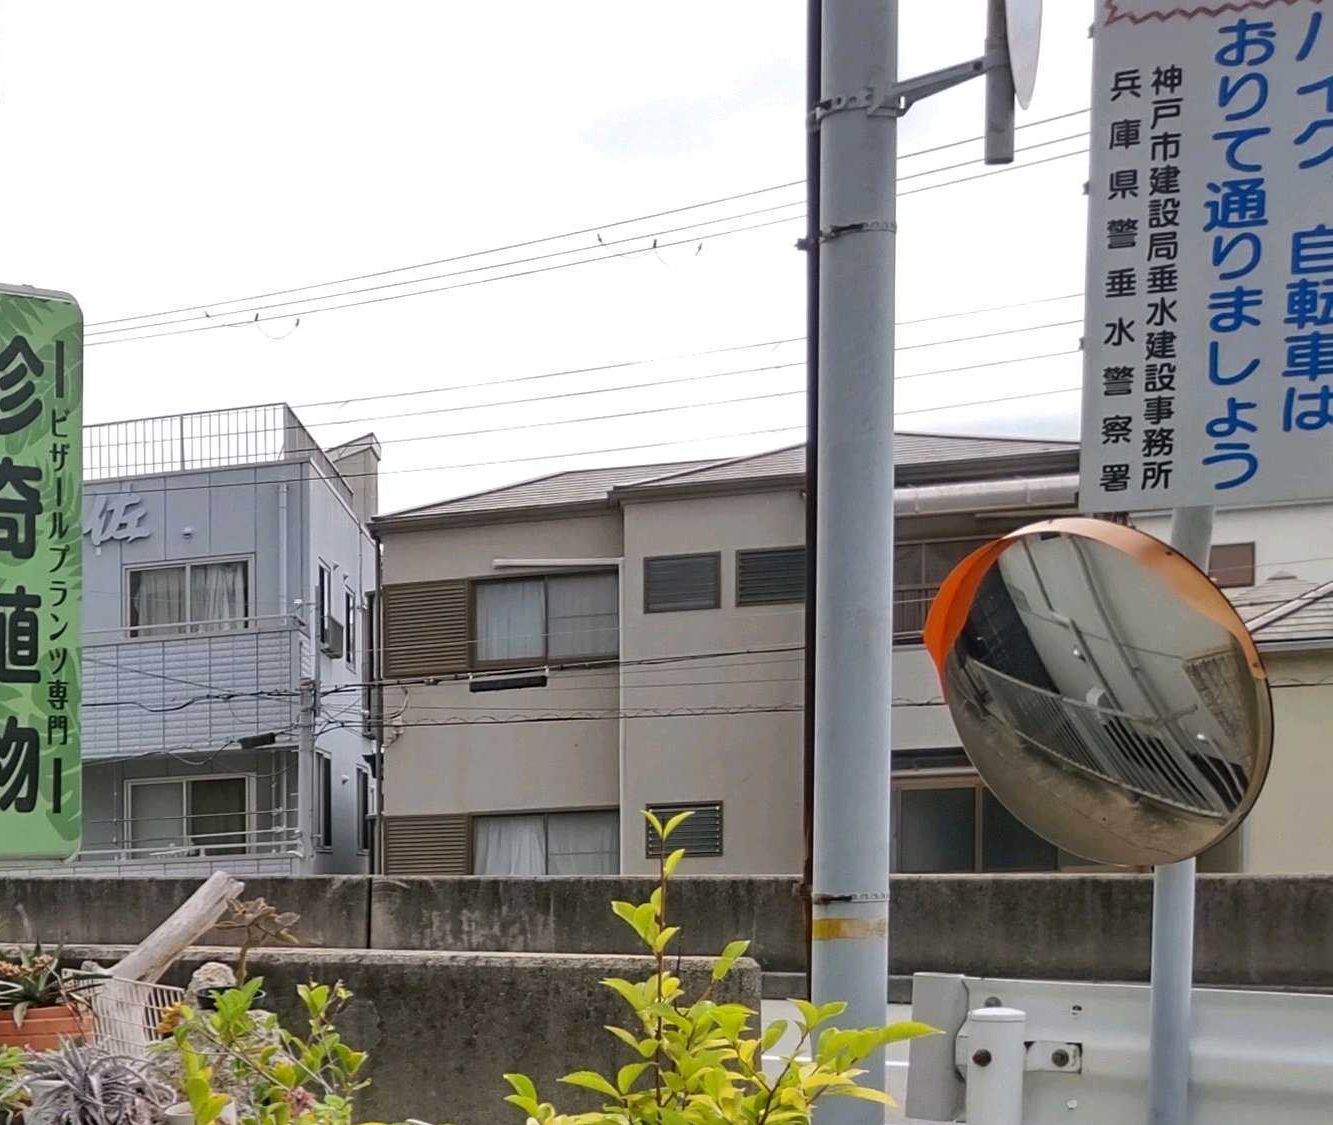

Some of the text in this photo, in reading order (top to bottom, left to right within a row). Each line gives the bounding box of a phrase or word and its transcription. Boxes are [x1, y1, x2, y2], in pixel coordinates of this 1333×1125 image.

[1099, 68, 1142, 493] 兵庫県警垂水警察署
[1141, 63, 1183, 491] 神戸市建設局垂水建設事務所
[1203, 18, 1276, 491] おりて通りましょう
